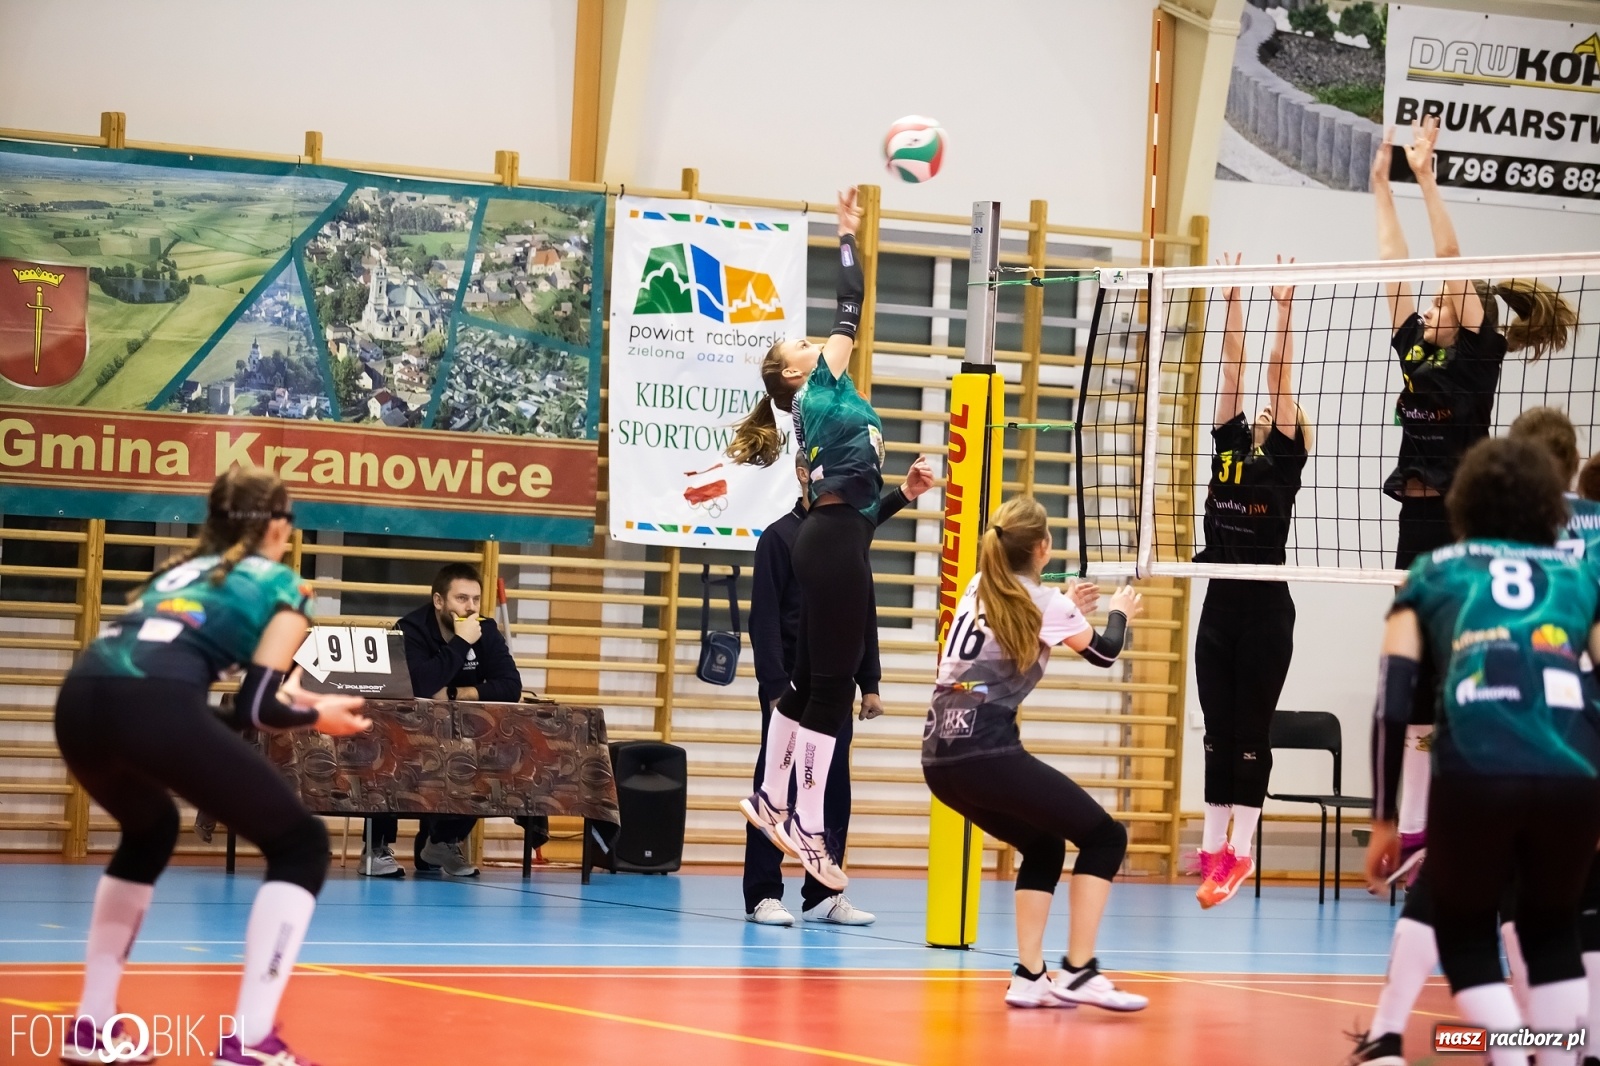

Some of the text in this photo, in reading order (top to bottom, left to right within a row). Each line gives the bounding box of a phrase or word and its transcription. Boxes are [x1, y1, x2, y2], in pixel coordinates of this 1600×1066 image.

[1447, 156, 1499, 184] 798
[1504, 162, 1555, 188] 636
[629, 323, 786, 348] powiat raciborski
[627, 344, 685, 360] zielona
[697, 352, 734, 363] oaza
[618, 419, 791, 455] SPORTOWM
[0, 417, 553, 498] Gmina Krzanowice
[1218, 451, 1244, 485] 31
[1488, 557, 1535, 610] 8
[327, 634, 343, 662] 9
[363, 635, 379, 664] 9
[946, 611, 987, 661] 16
